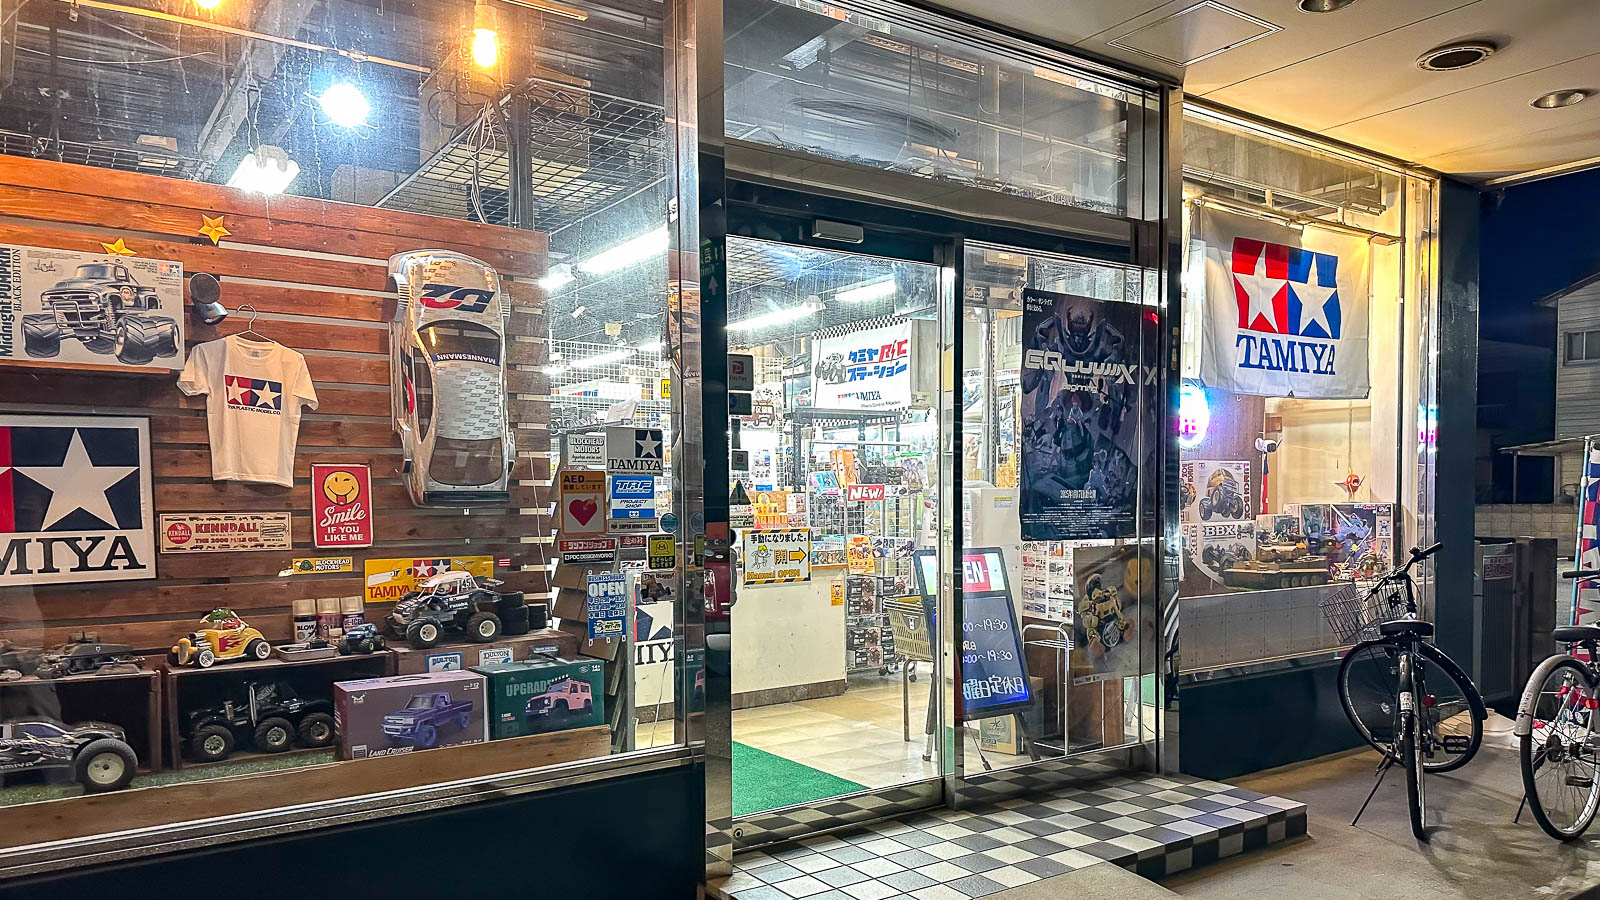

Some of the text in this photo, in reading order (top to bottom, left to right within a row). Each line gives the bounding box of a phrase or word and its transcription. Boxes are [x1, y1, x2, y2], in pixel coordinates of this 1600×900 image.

[11, 248, 22, 312] BLACK EDITION
[436, 353, 496, 364] MANNESMANN
[1235, 334, 1336, 376] TAMIYA
[621, 367, 660, 378] Futaba
[847, 361, 908, 382] ステーション
[574, 445, 600, 453] MOTORS
[608, 459, 662, 471] TAMIYA
[563, 475, 585, 483] AED
[616, 480, 652, 490] TRF
[850, 486, 883, 501] NEW!
[320, 502, 366, 527] Smile
[339, 525, 359, 533] YOU
[1204, 525, 1234, 536] BBX
[324, 533, 364, 542] LIKE ME
[750, 533, 807, 544] 手動になりました。
[315, 558, 350, 567] BLOCKHEAD
[774, 549, 788, 565] 開
[747, 569, 800, 580] Manual OPEN
[588, 581, 625, 597] OPEN
[432, 655, 458, 664] DULTON
[483, 650, 509, 660] DULTON
[368, 746, 414, 758] LAND CRUISER
